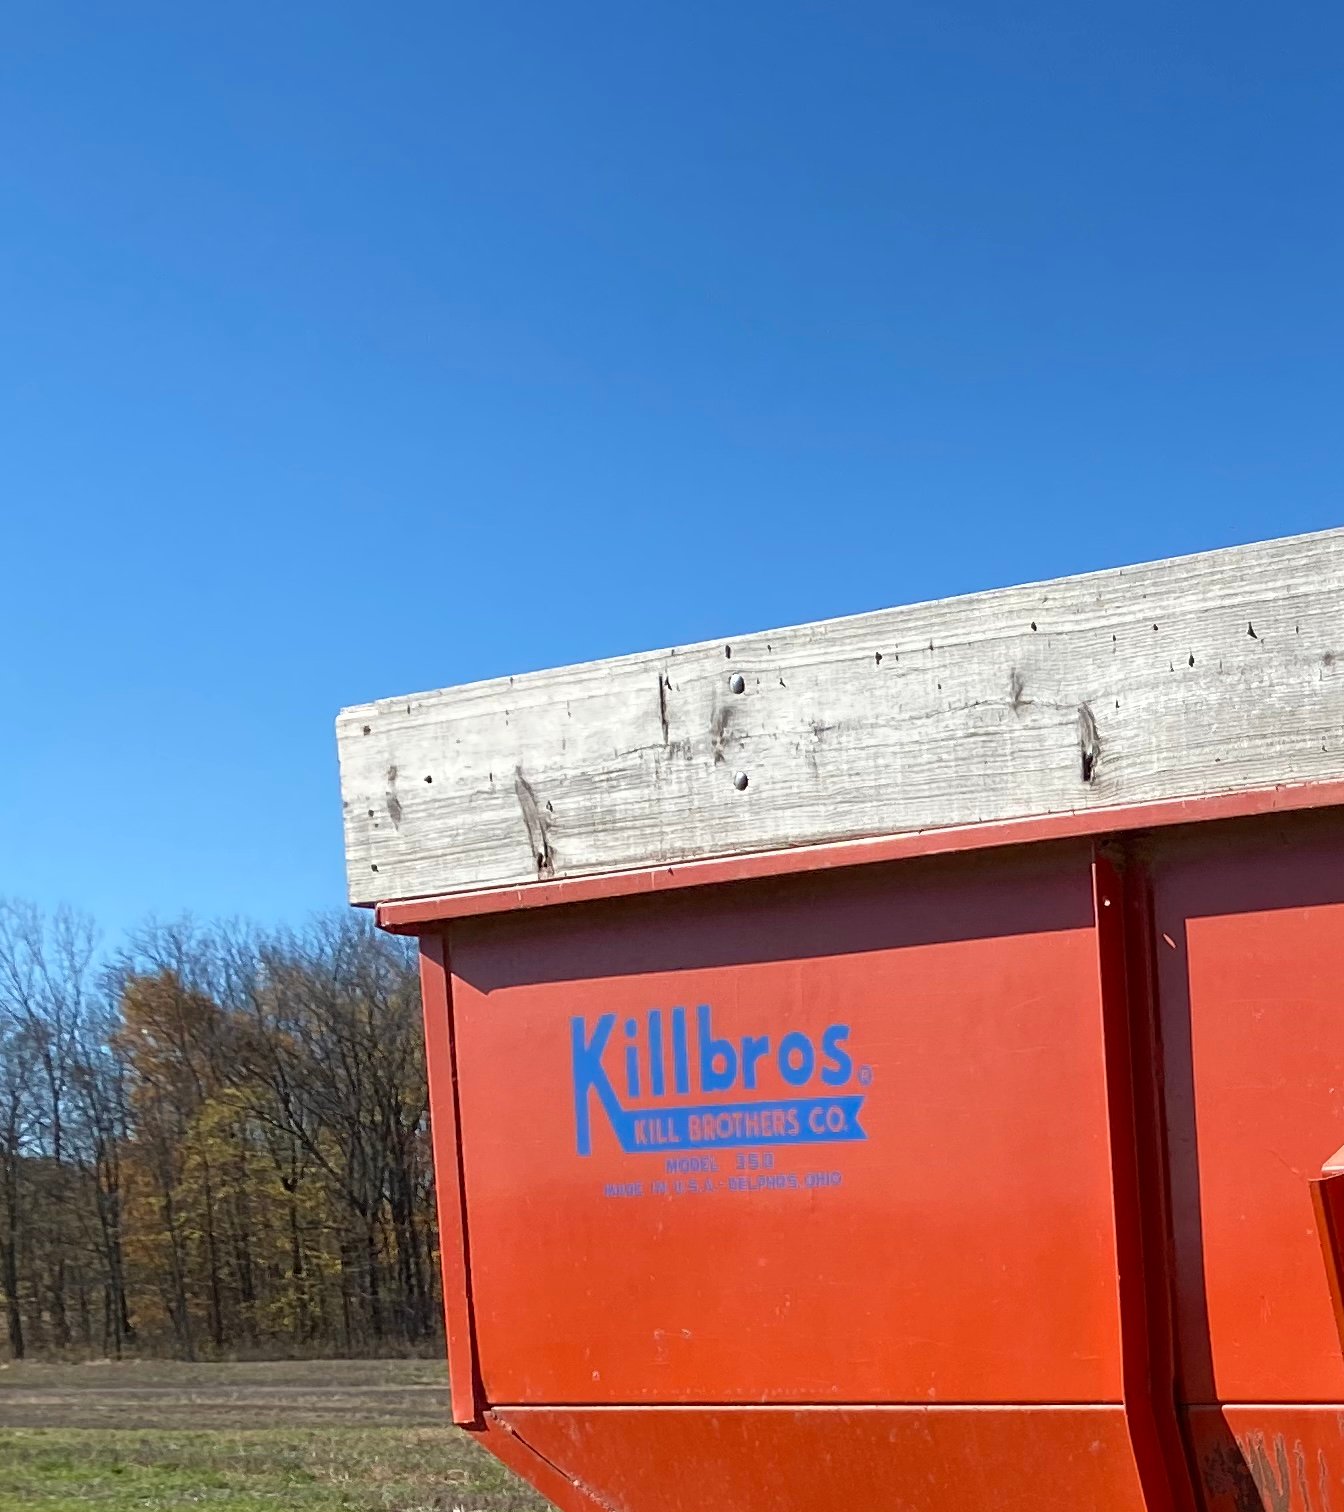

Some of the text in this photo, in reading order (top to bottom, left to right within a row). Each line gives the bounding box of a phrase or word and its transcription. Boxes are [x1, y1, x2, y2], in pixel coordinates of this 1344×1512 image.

[570, 1004, 853, 1156] Killbros
[633, 1118, 682, 1146] KILL
[687, 1107, 800, 1142] BROTHERS
[665, 1155, 719, 1173] MODEL
